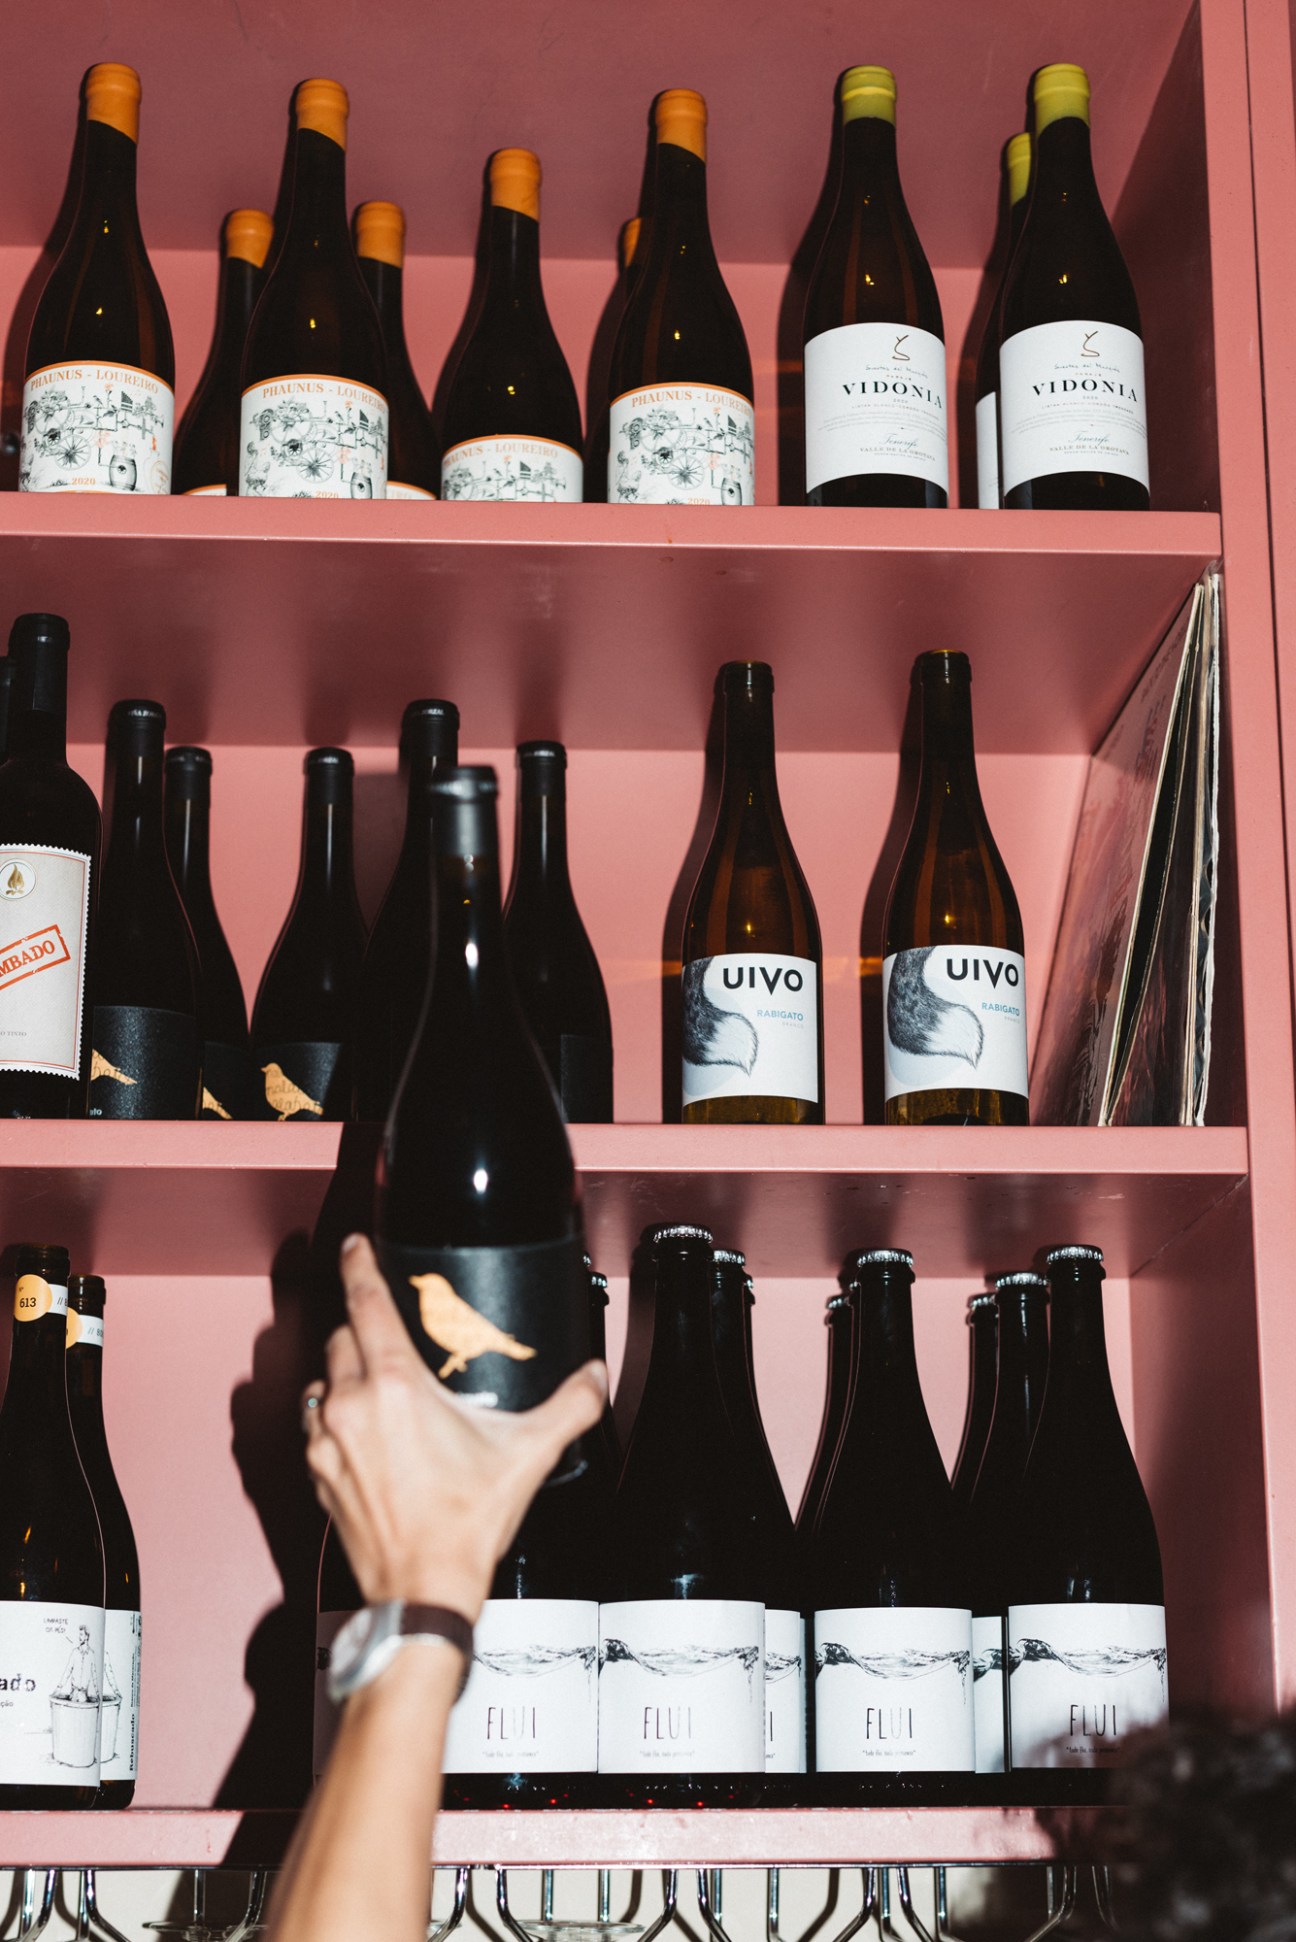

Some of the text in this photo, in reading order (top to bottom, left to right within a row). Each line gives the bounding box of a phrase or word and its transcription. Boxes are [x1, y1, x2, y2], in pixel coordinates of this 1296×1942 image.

[30, 369, 159, 394] PHAUNUS LOUREIRO
[262, 383, 324, 398] PHAUNUS
[1032, 379, 1138, 403] VIDONIA
[631, 390, 692, 407] PHAUNUS
[842, 380, 942, 409] VIDONIA
[495, 442, 558, 458] LOUREIRO
[71, 477, 96, 485] 2020
[723, 967, 804, 996] UIVO
[946, 958, 1019, 989] UIVO
[756, 1010, 804, 1022] RABIGATO
[981, 1002, 1020, 1017] RABIGATO
[20, 1297, 37, 1308] 613
[487, 1706, 536, 1740] FLUI
[643, 1706, 692, 1740] FLUI
[866, 1707, 913, 1740] FLUI
[1070, 1704, 1117, 1737] FLUI
